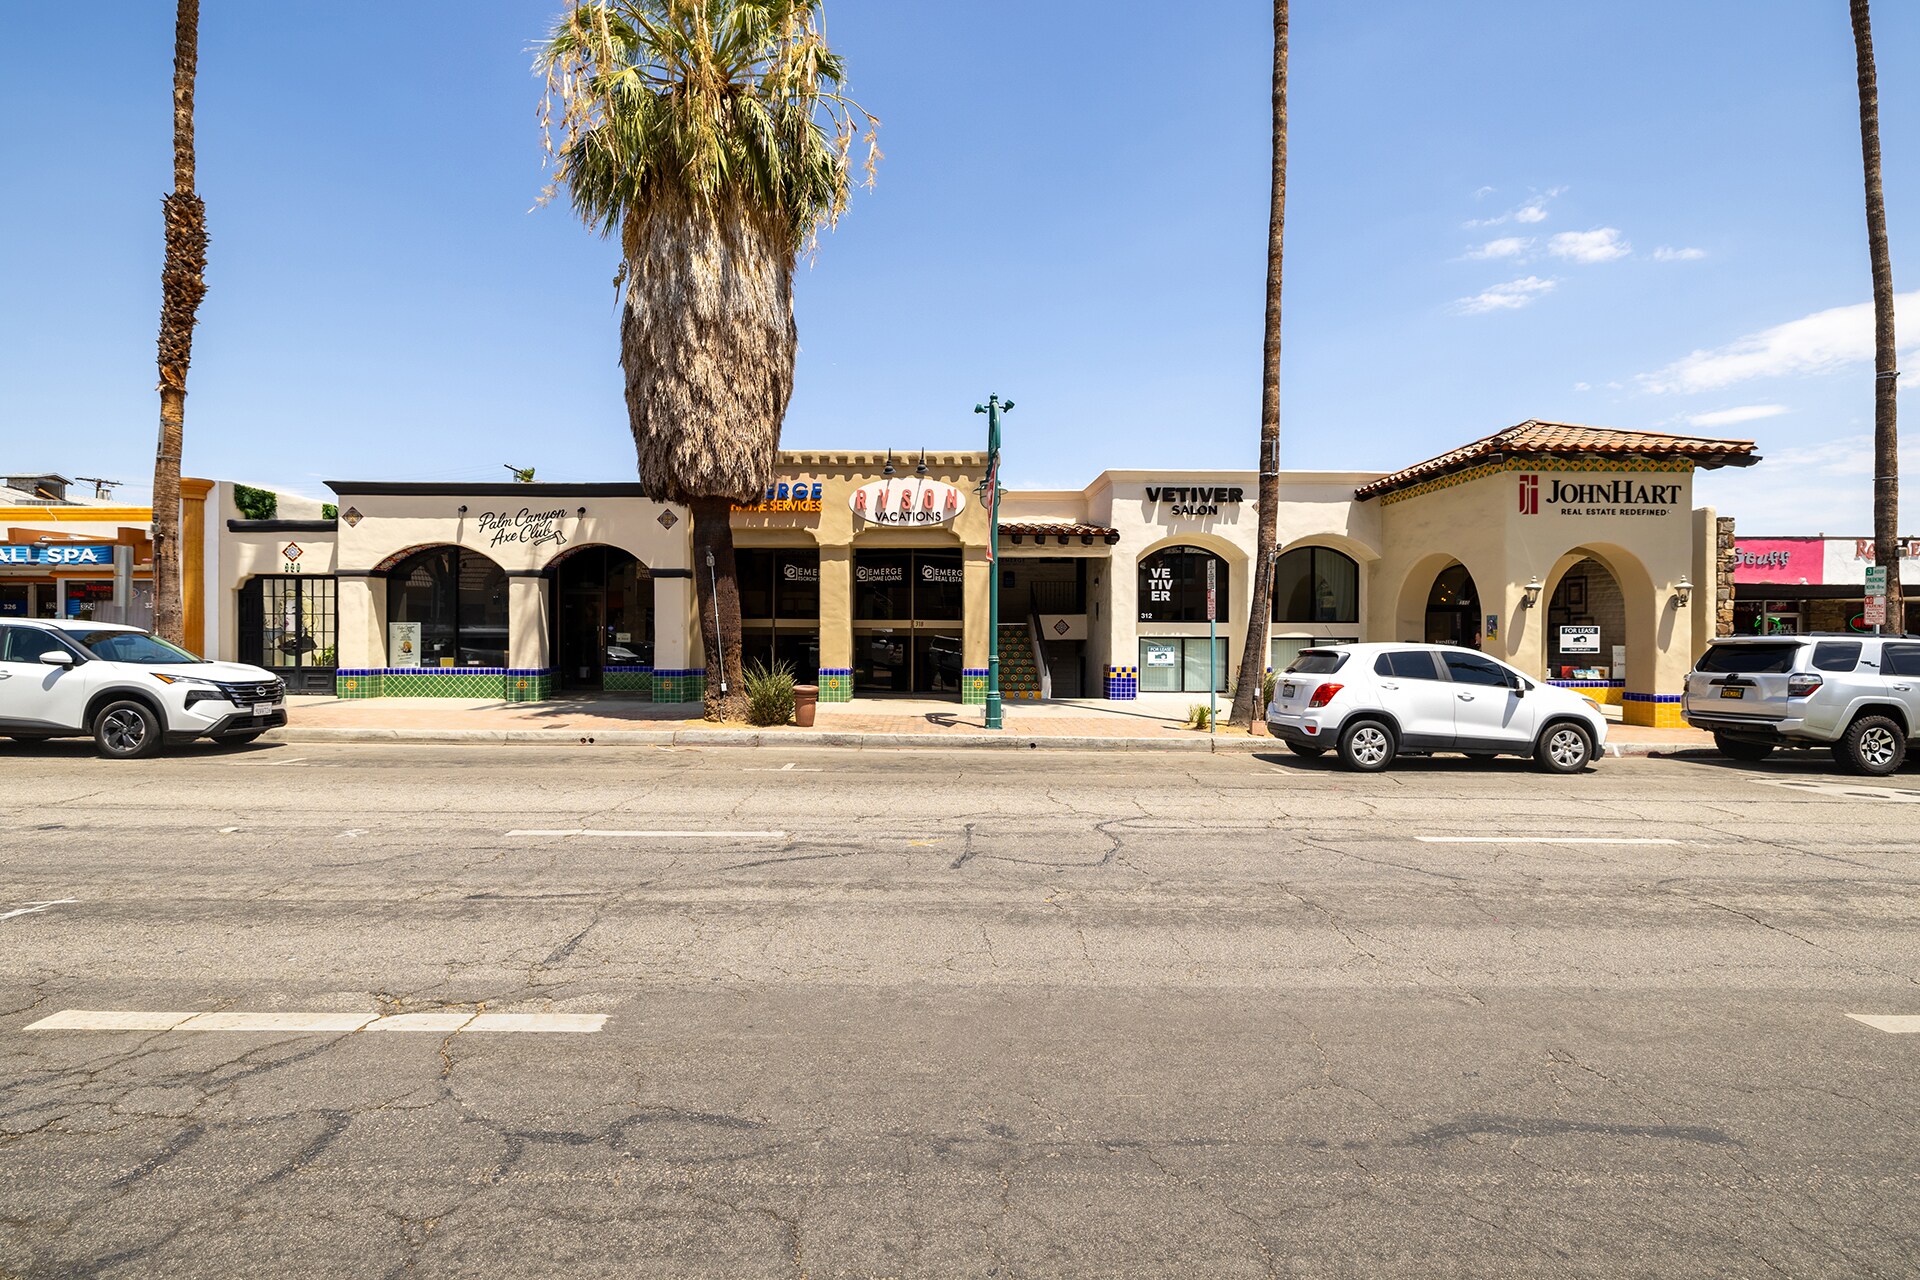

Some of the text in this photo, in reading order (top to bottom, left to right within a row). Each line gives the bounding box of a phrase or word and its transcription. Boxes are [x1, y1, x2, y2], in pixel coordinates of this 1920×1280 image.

[857, 489, 957, 510] RYSON
[1145, 487, 1243, 502] VETIVER
[769, 500, 822, 511] SERVICES
[1172, 505, 1217, 515] SALON
[875, 512, 941, 521] VACATIONS
[1619, 508, 1667, 516] REDEFINED
[478, 508, 567, 533] Palm Canyon
[490, 520, 552, 548] Axe Club
[47, 548, 98, 562] SPA
[869, 568, 902, 576] EMERGE
[1151, 568, 1171, 578] VE
[1867, 567, 1873, 575] 3
[1148, 580, 1173, 590] TIV
[1151, 591, 1171, 601] ER
